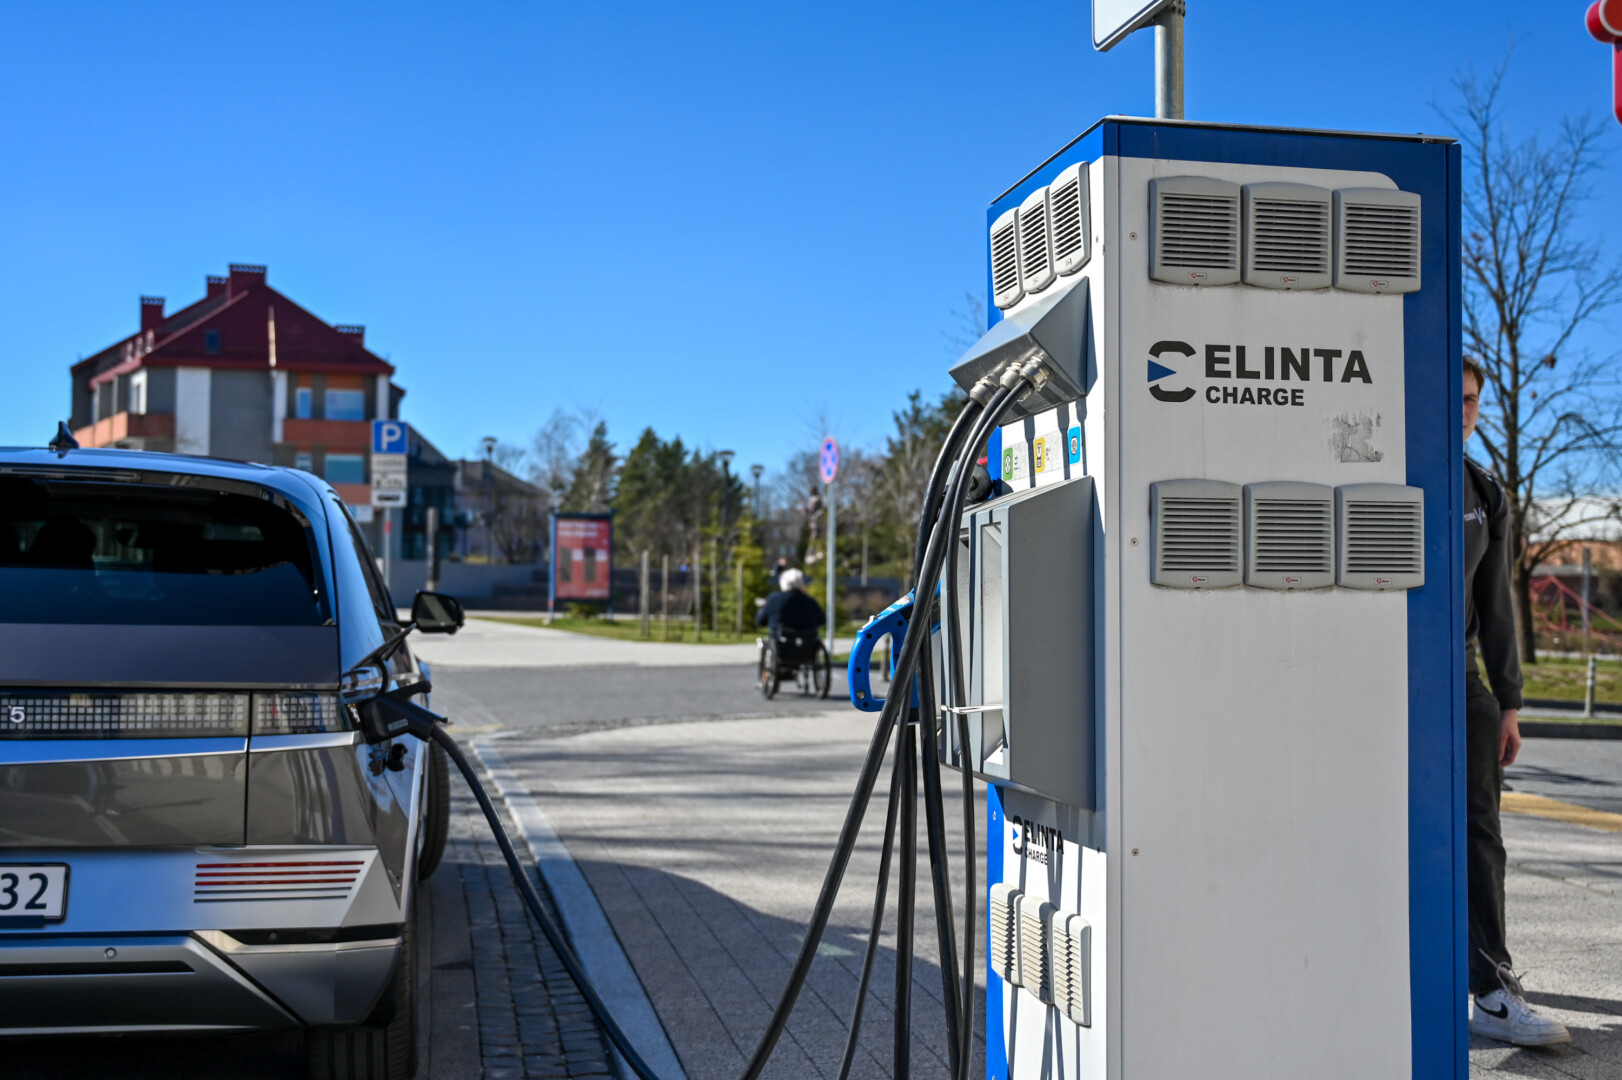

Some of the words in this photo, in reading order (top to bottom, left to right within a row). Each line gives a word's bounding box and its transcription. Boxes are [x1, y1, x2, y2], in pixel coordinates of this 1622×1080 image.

[1205, 344, 1373, 384] ELINTA
[1205, 386, 1304, 406] CHARGE
[382, 424, 402, 451] P
[10, 706, 25, 723] 5
[1024, 819, 1064, 855] ELINTA
[1025, 846, 1048, 866] CHARGE
[0, 872, 49, 911] 32
